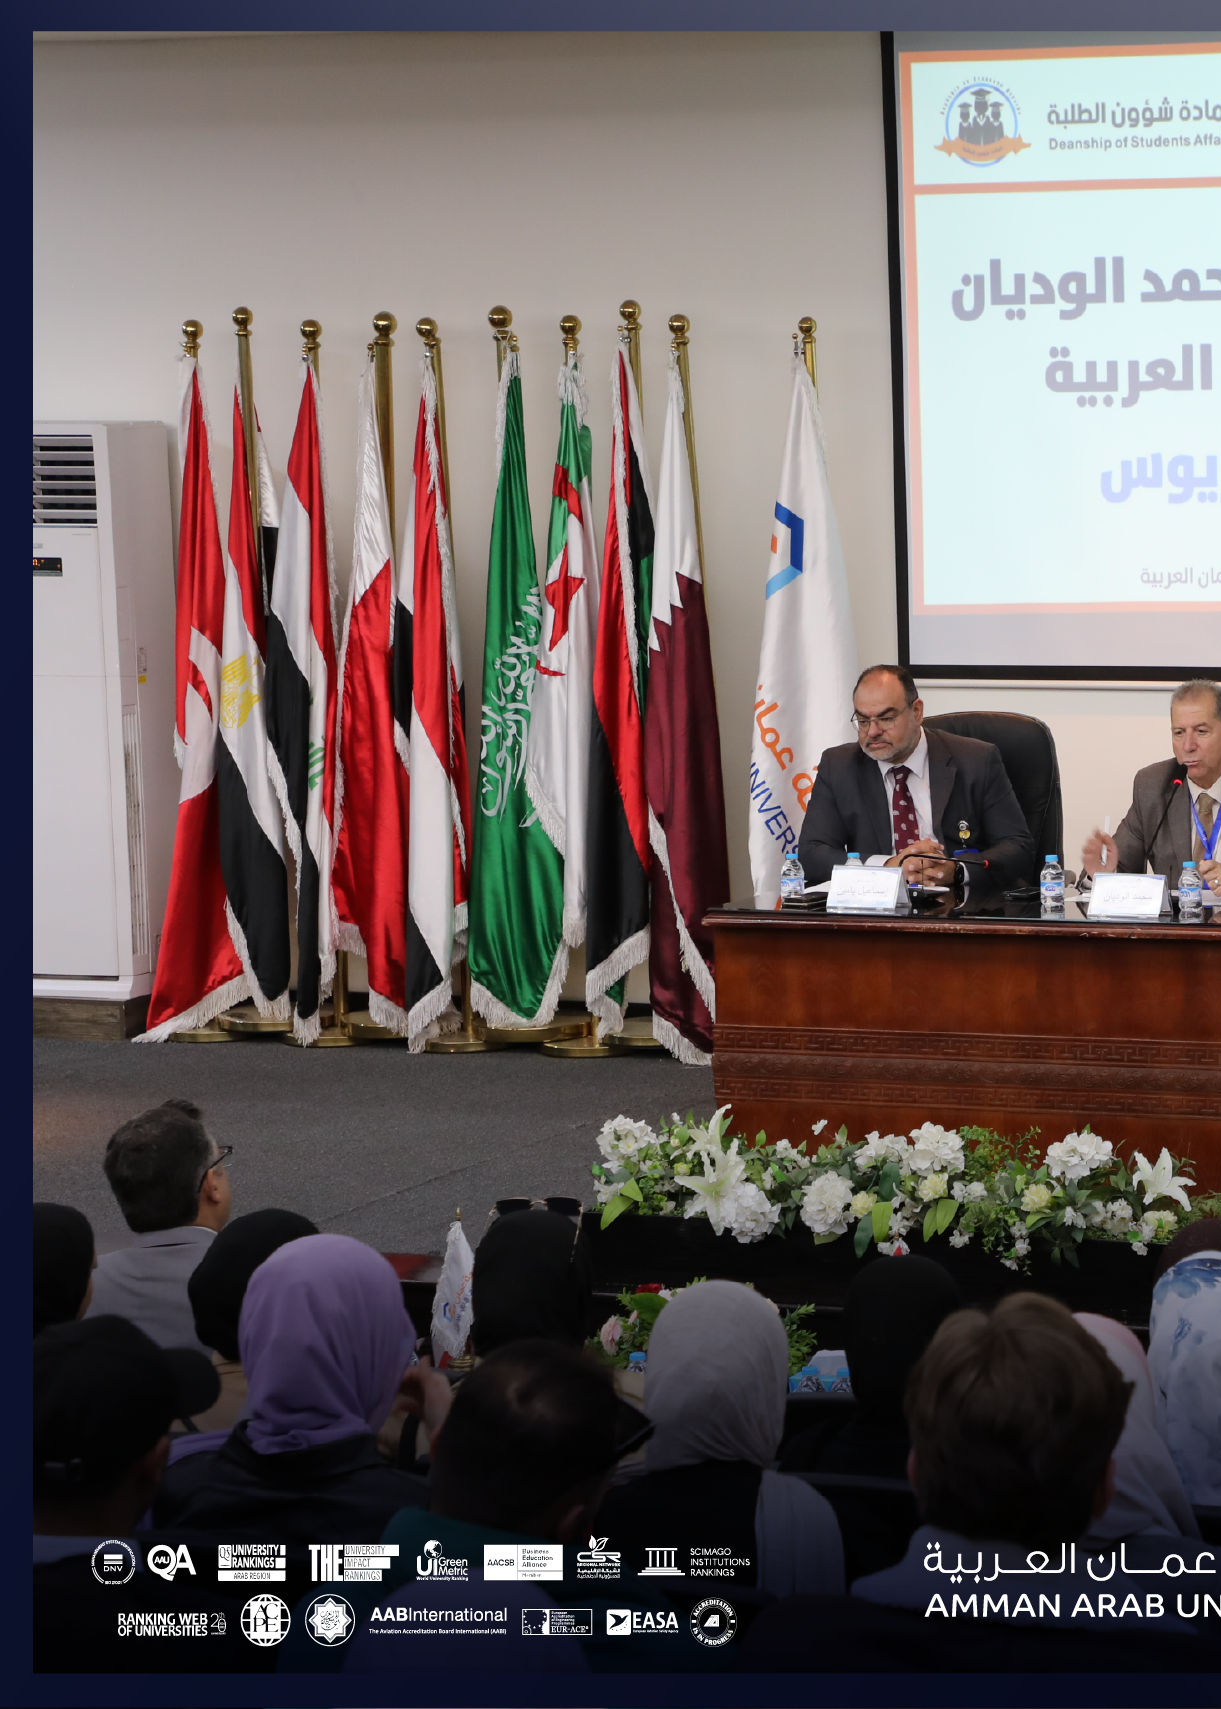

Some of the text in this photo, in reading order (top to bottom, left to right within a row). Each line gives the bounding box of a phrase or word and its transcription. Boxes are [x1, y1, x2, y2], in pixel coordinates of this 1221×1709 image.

[1047, 102, 1106, 129] الطلبة
[1111, 97, 1173, 128] شؤون
[1049, 137, 1112, 151] Deanship
[1115, 136, 1128, 148] of
[1131, 135, 1191, 148] Students
[951, 256, 1125, 321] الوديان
[1045, 343, 1212, 407] العربية
[1141, 567, 1193, 589] العربية
